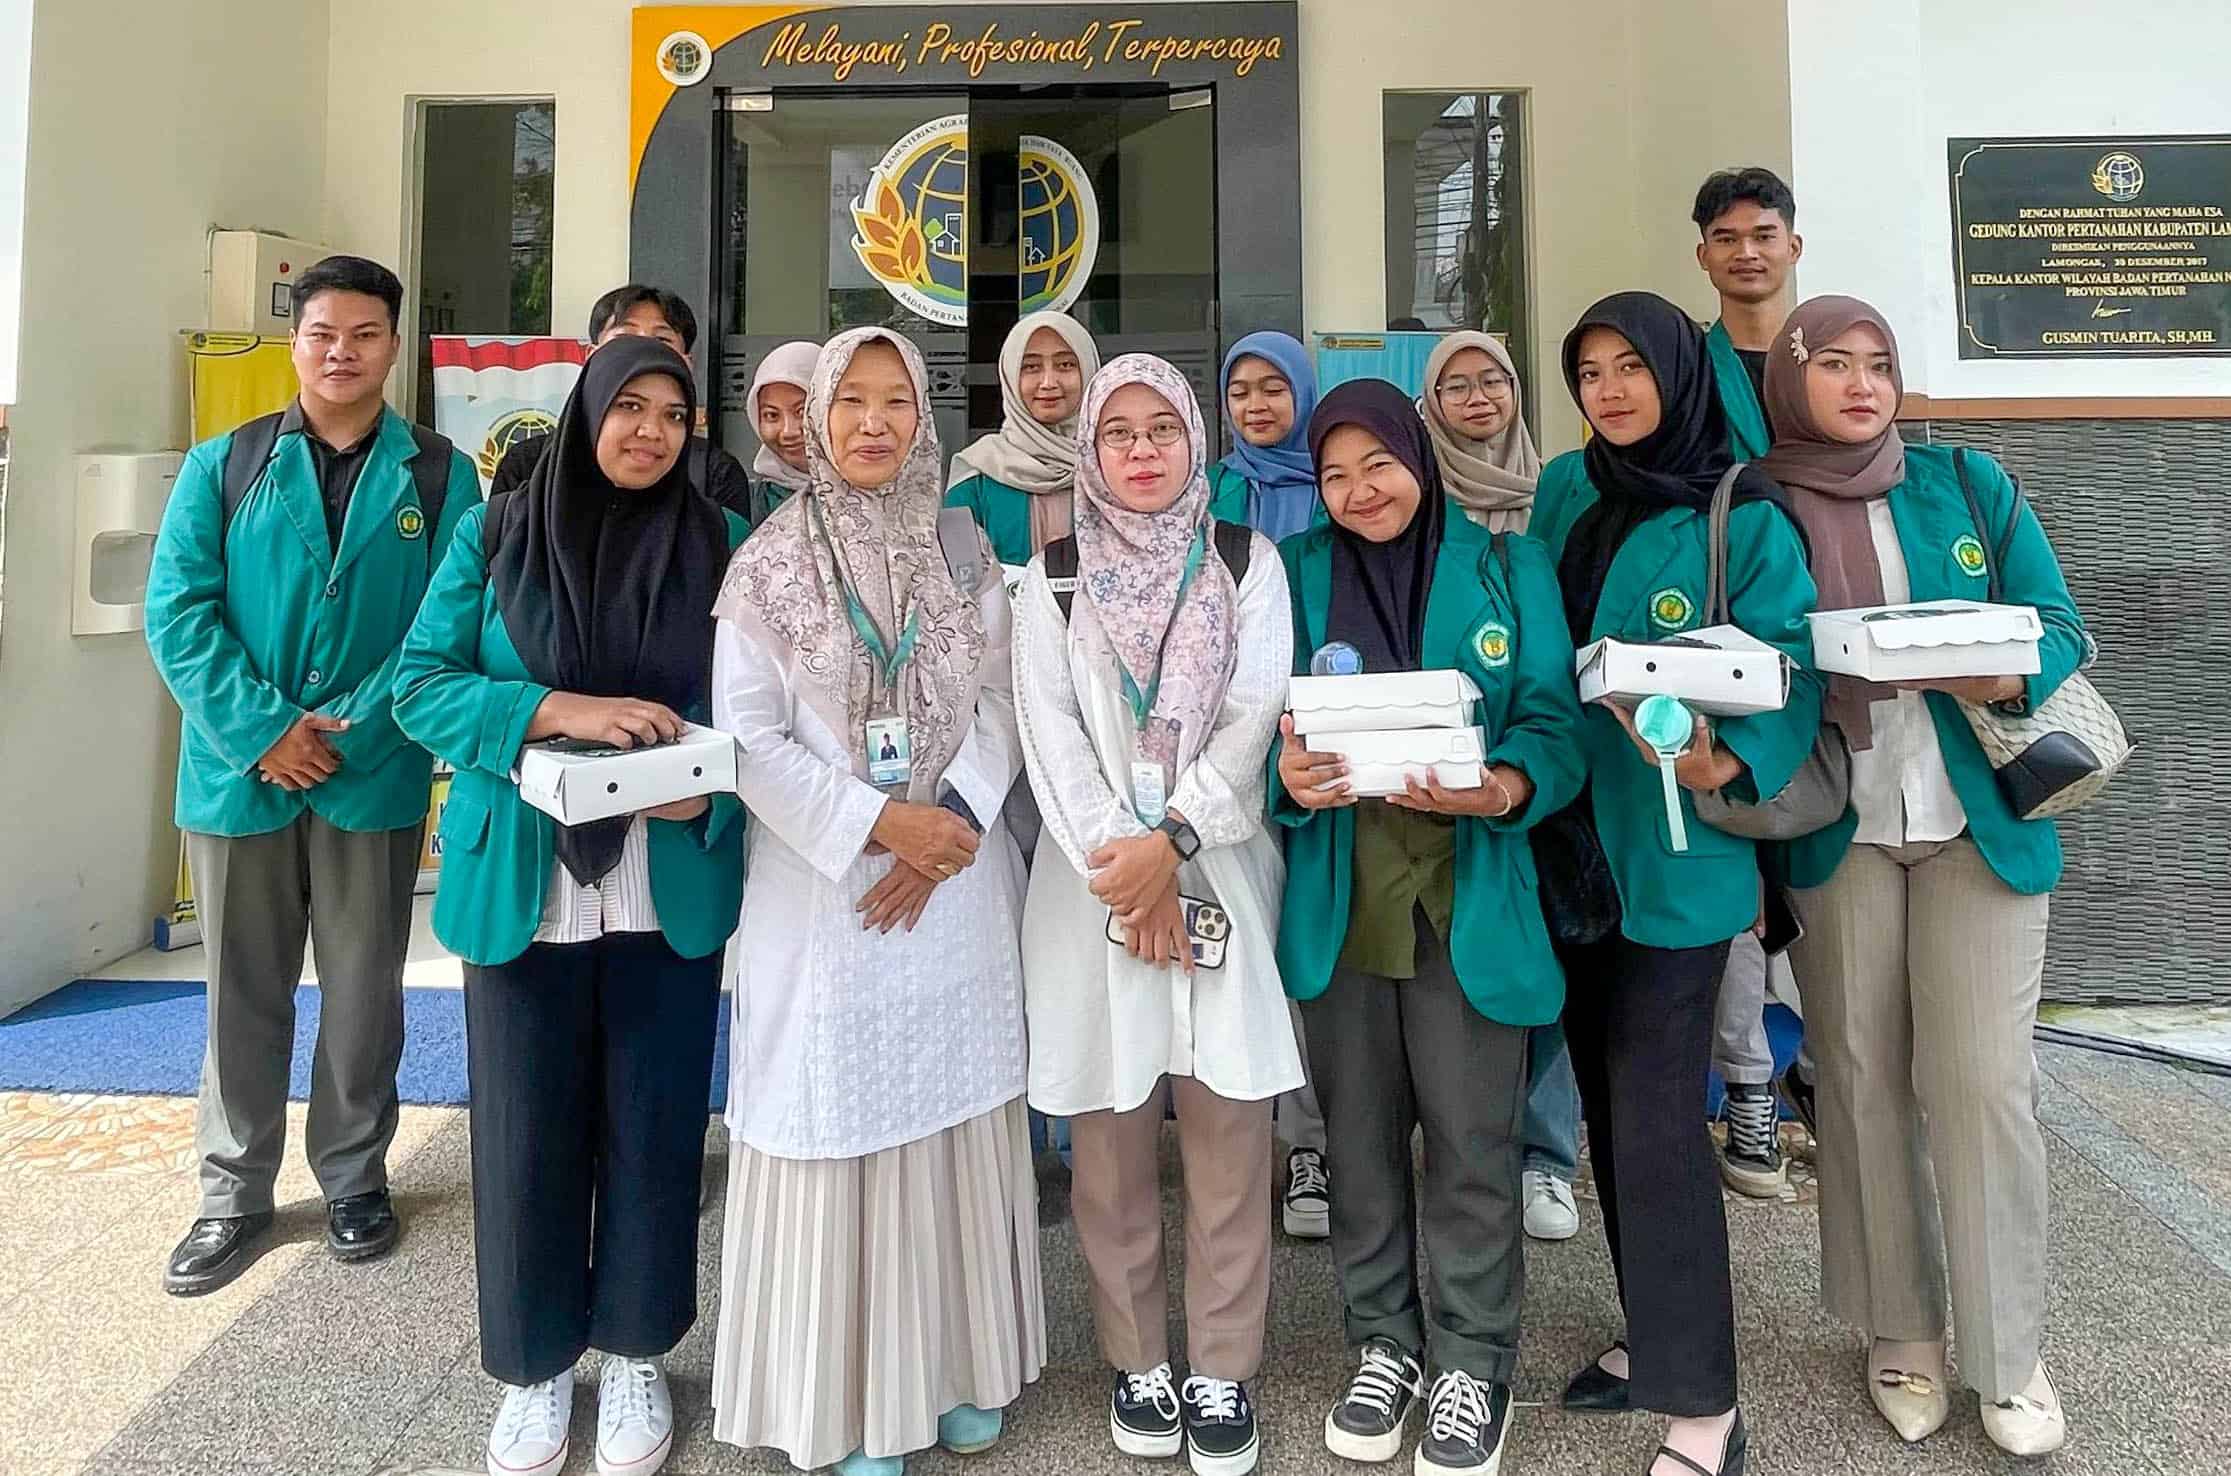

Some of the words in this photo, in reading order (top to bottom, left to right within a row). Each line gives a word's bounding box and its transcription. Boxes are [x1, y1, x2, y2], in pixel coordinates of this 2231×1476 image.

[761, 22, 911, 81] Melayani,
[917, 23, 1101, 78] Profesional,
[1103, 19, 1283, 77] Terpercaya
[2019, 208, 2062, 219] DENGAN
[2063, 207, 2106, 218] RAHMAT
[2106, 207, 2142, 218] TUHAN
[2143, 206, 2172, 218] YANG
[2172, 206, 2203, 217] MAHA
[2204, 206, 2224, 217] ESA
[1968, 223, 2017, 238] GEDUNG
[2018, 223, 2066, 238] KANTOR
[2067, 222, 2142, 237] PERTANAHAN
[2143, 222, 2210, 237] KABUPATEN
[2127, 257, 2185, 267] DESEMBER
[1971, 273, 2014, 285] KEPALA
[2014, 273, 2061, 284] KANTOR
[2061, 272, 2111, 284] WILAYAH
[2112, 272, 2150, 283] BADAN
[2151, 271, 2223, 283] PERTANAHAN
[2065, 286, 2118, 297] PROVINSI
[2118, 286, 2148, 296] JAWA
[2148, 286, 2187, 296] TIMUR
[2042, 331, 2099, 345] GUSMIN
